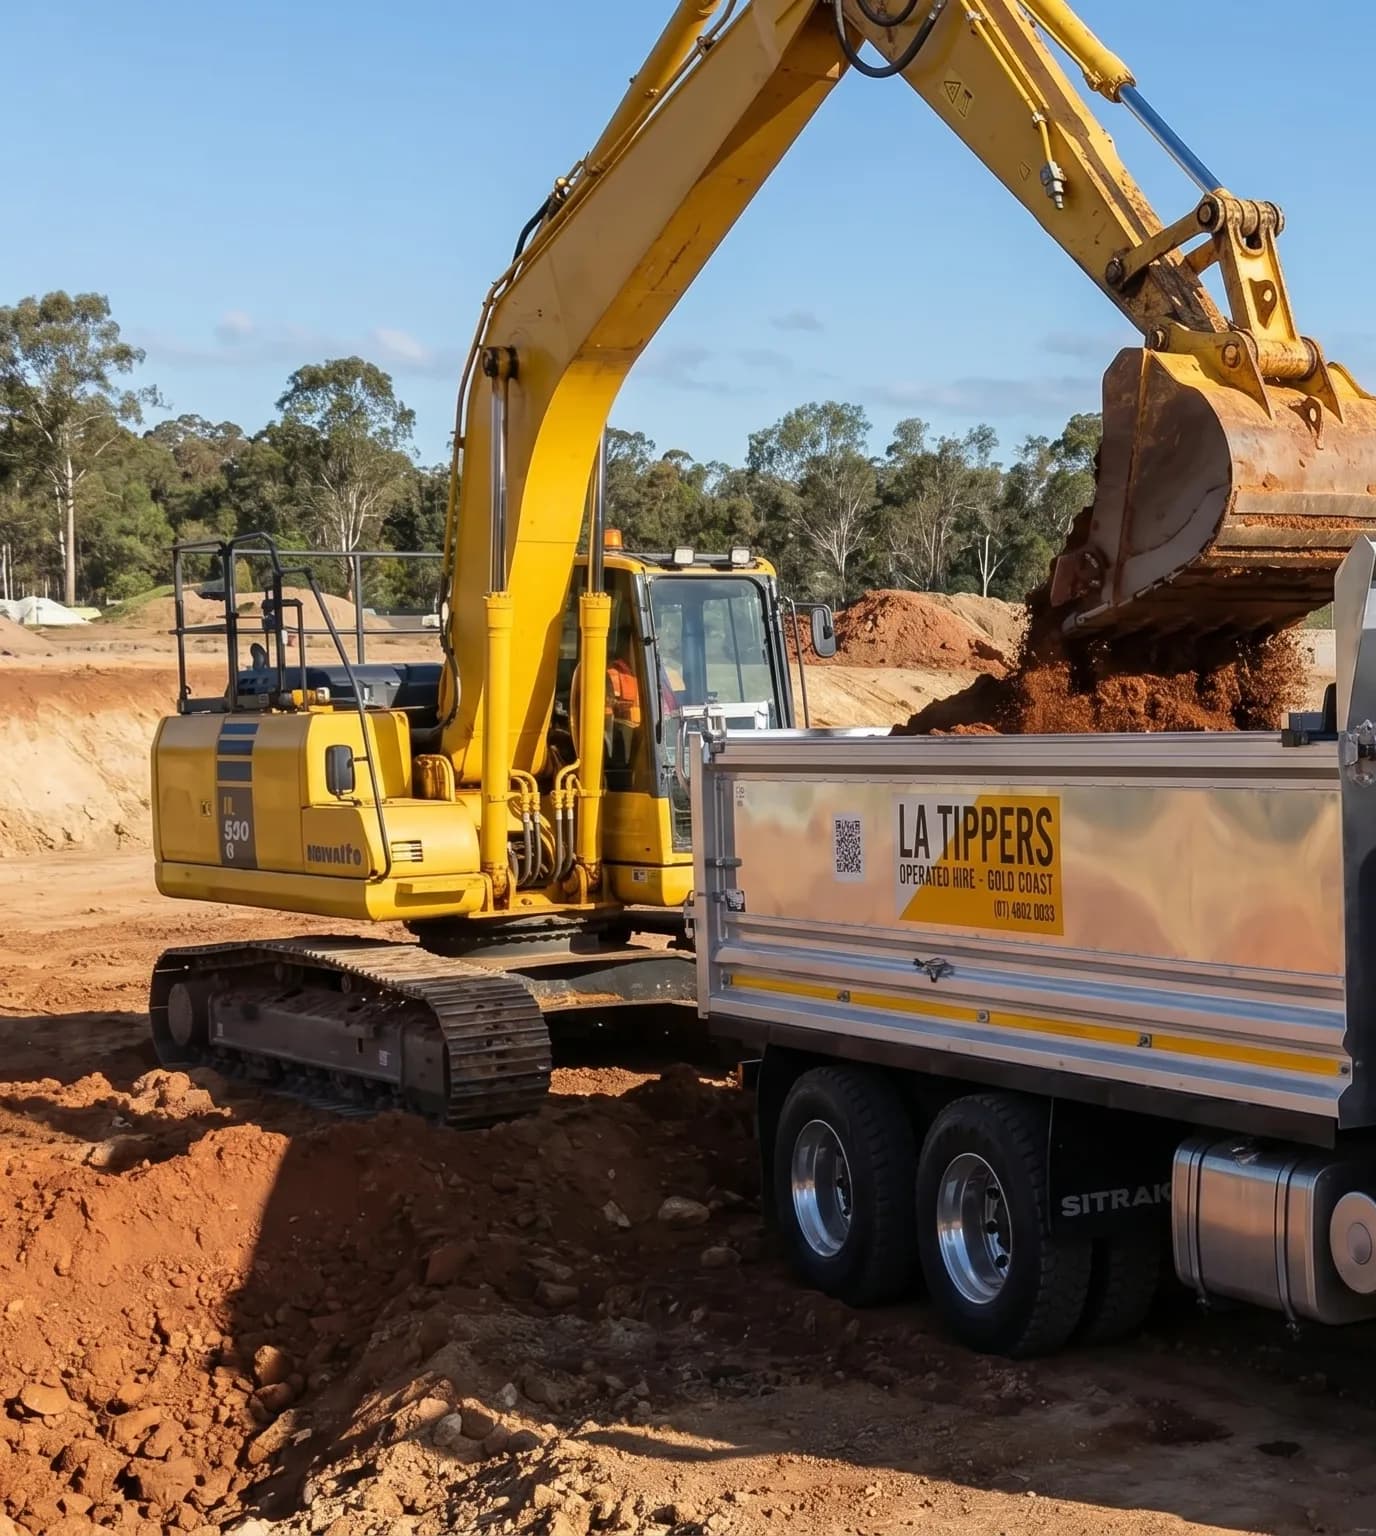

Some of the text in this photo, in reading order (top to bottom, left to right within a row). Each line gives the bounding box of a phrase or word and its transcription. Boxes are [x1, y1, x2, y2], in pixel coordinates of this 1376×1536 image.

[899, 804, 1053, 867] LA TIPPERS
[900, 864, 949, 888] OPERATED
[953, 868, 975, 889] HIRE
[988, 869, 1014, 892] GOLD
[1018, 871, 1053, 896] COAST
[1011, 902, 1032, 920] 4802
[1034, 903, 1055, 922] 0033
